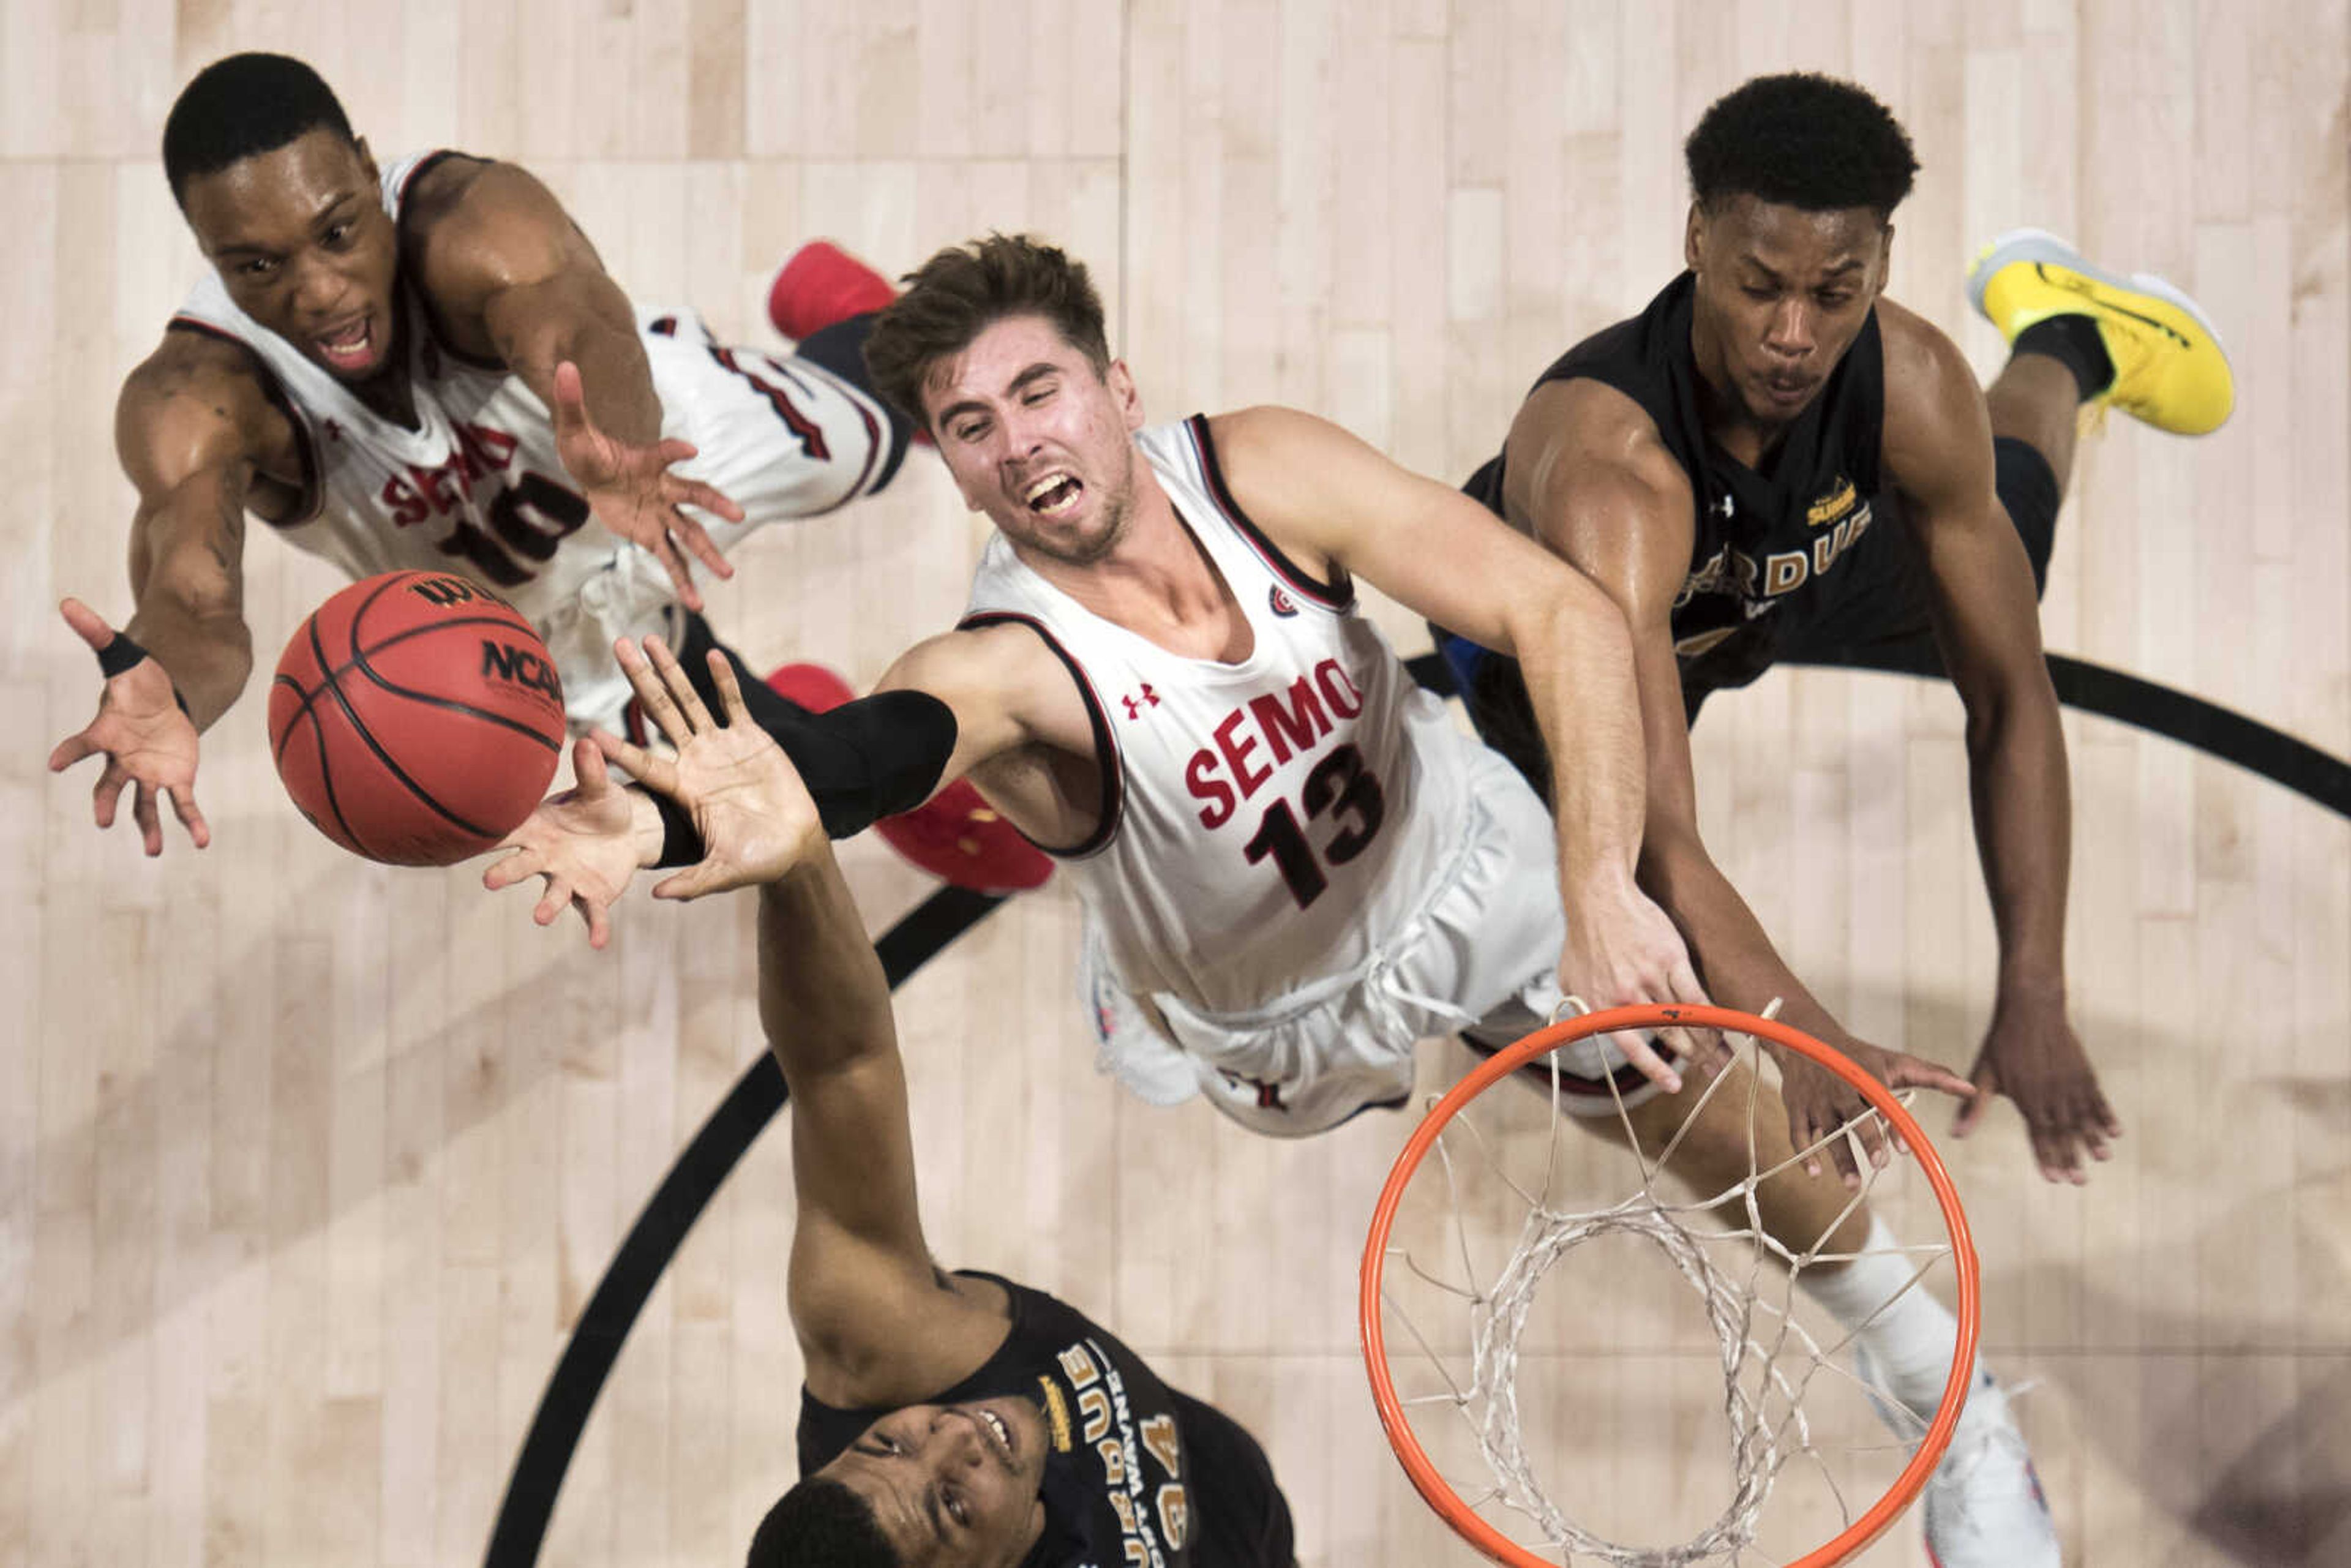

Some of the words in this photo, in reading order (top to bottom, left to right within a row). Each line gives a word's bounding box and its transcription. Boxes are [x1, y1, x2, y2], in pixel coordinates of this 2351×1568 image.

[438, 470, 590, 587] 10
[1185, 658, 1363, 830] SEMO
[1243, 743, 1384, 910] 13
